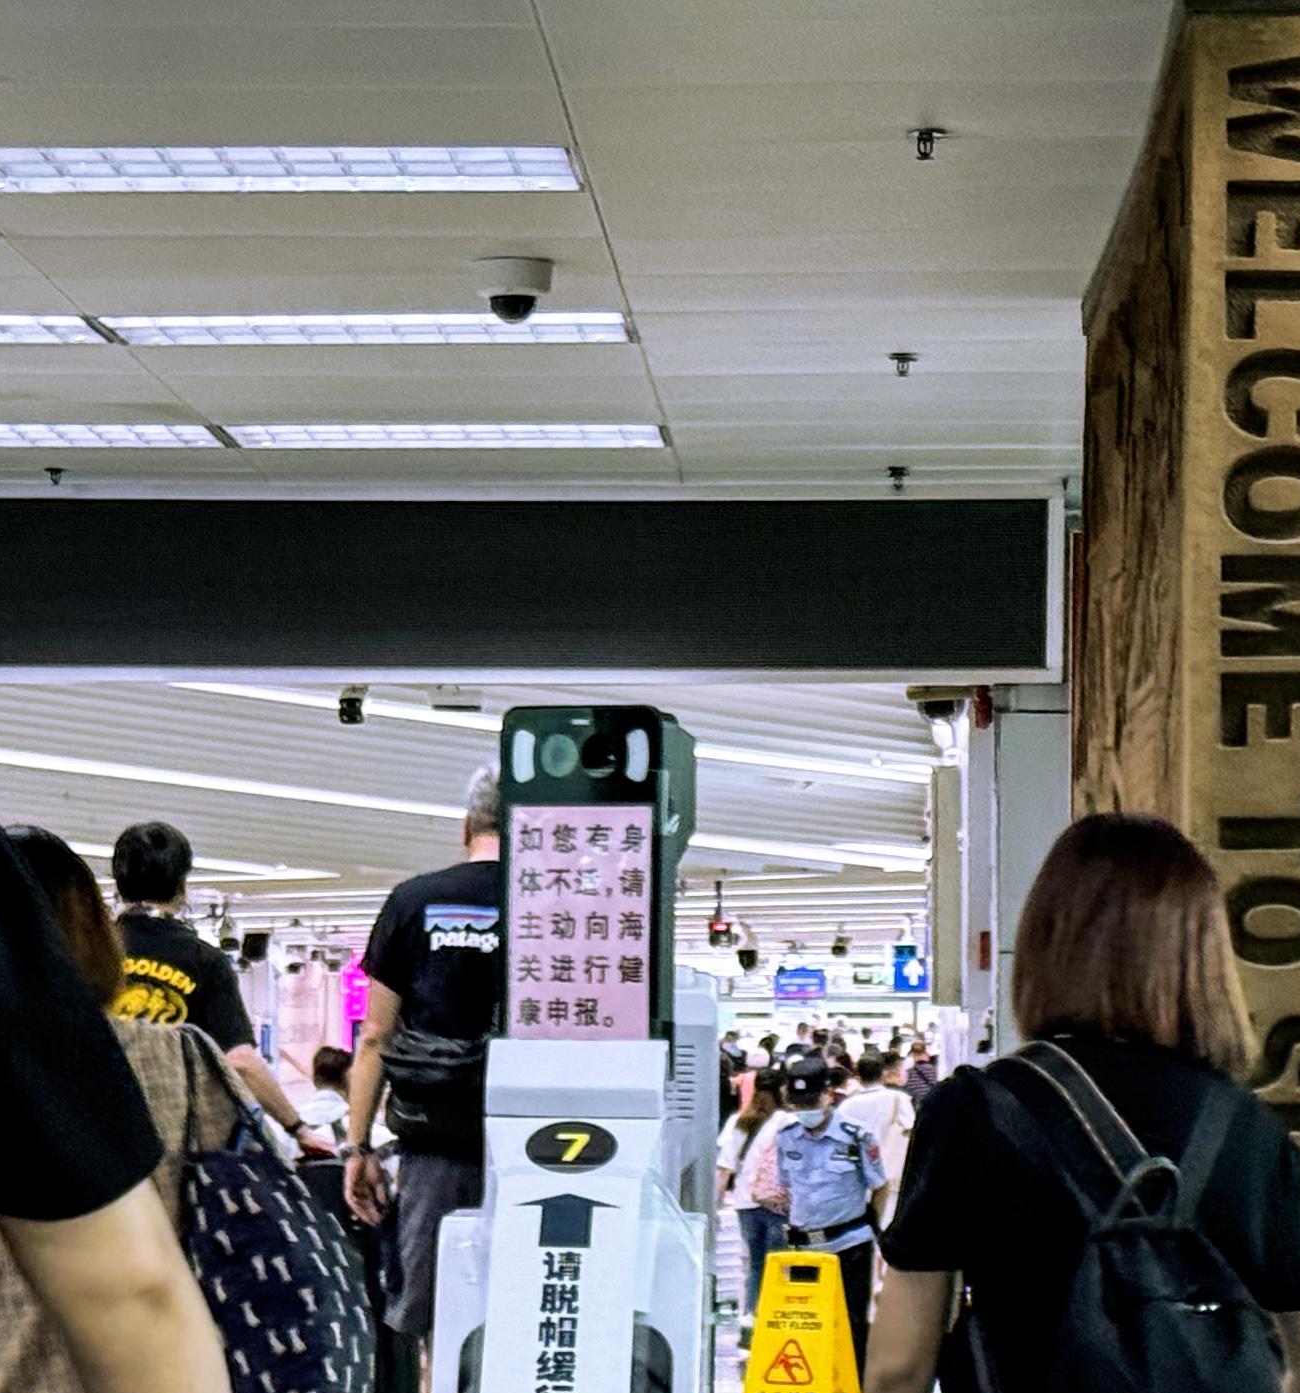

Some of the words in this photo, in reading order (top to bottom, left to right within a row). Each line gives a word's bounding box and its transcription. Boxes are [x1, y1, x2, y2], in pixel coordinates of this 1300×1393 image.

[517, 823, 646, 855] 如您有身
[516, 911, 645, 941] 主动向海
[122, 957, 197, 995] GOLDEN
[515, 954, 645, 985] 关进行健
[515, 996, 614, 1029] 康申报。
[555, 1131, 592, 1164] 7
